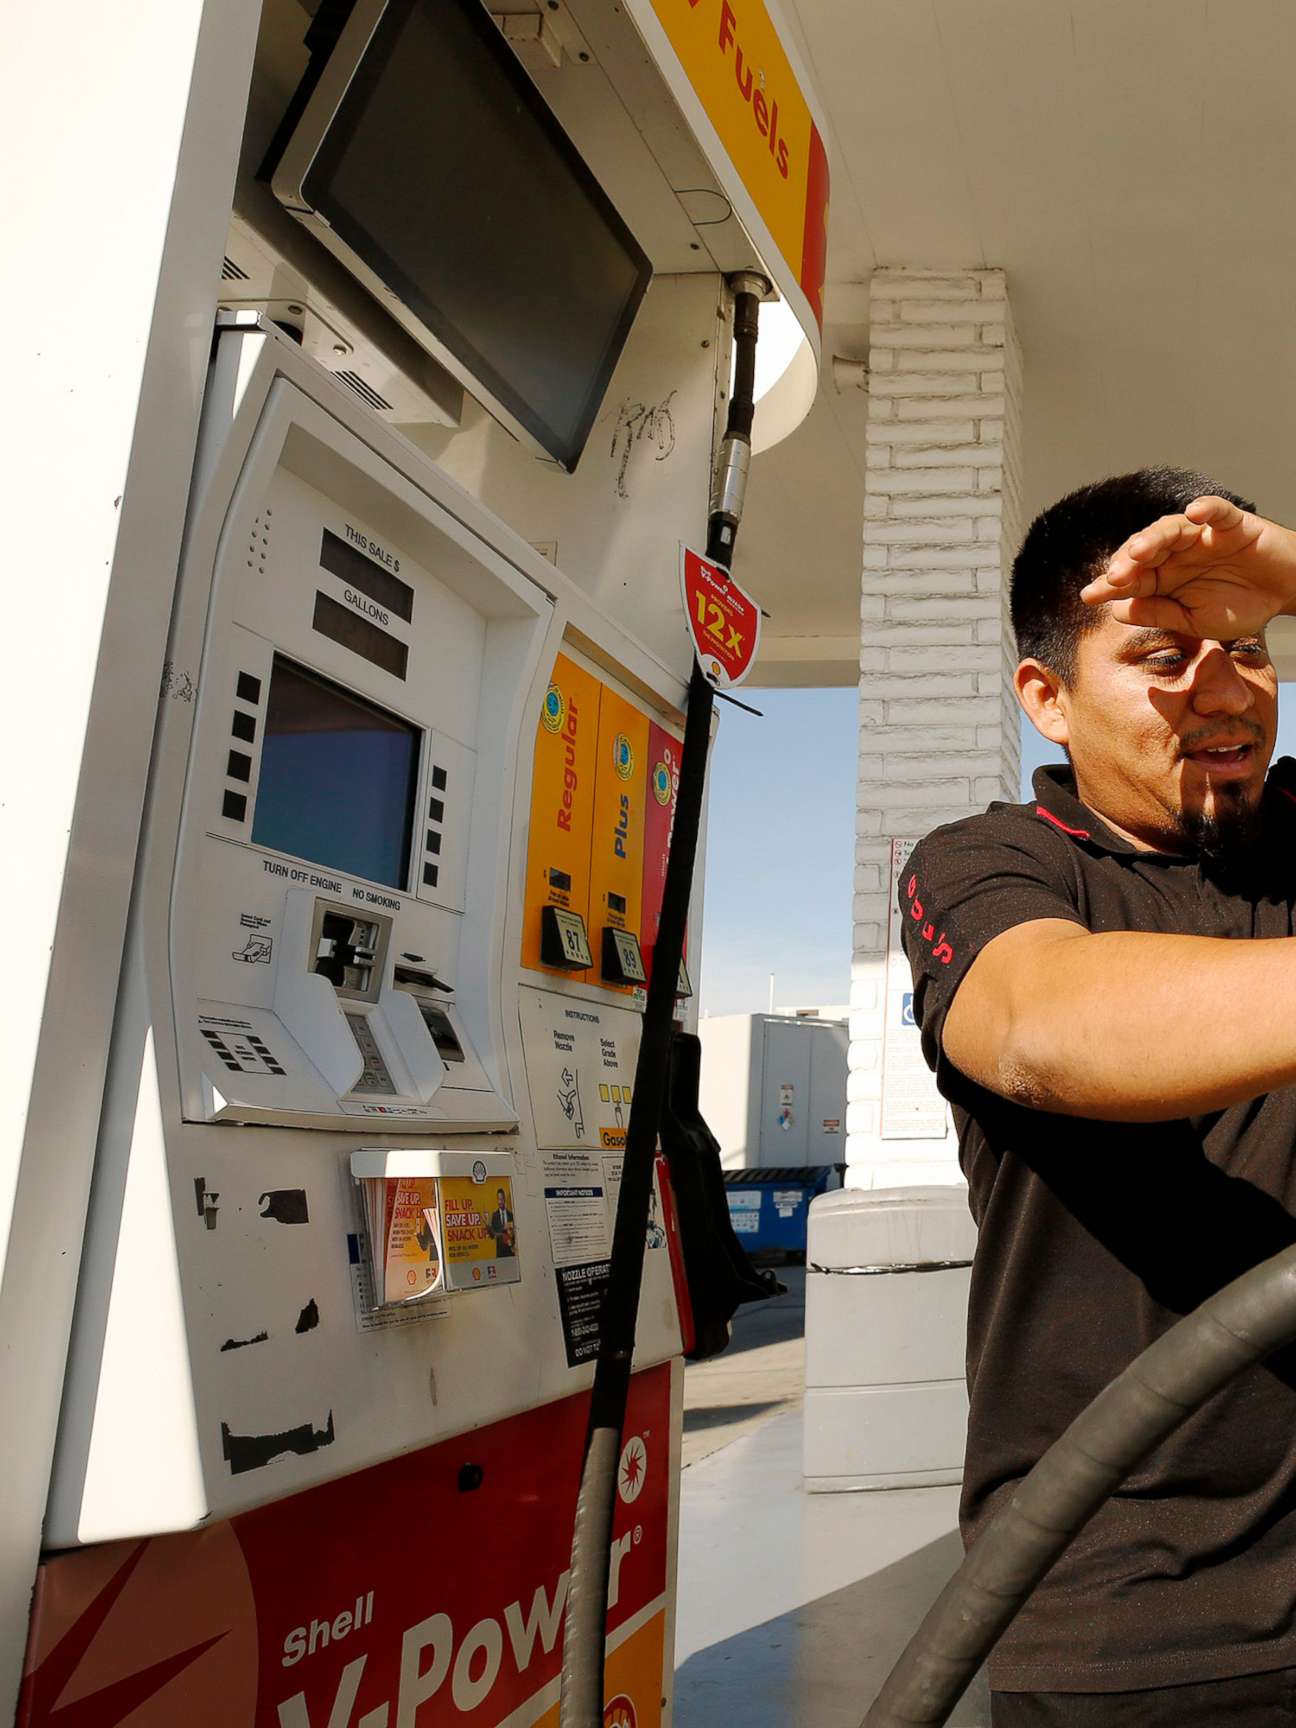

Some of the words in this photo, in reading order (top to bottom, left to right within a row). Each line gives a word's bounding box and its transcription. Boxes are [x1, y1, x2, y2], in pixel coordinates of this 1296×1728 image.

[719, 0, 788, 179] Fuels
[345, 524, 367, 548] THIS
[369, 542, 392, 567] SALE
[394, 560, 400, 572] $
[344, 589, 389, 625] GALLONS
[557, 697, 578, 832] Regular
[614, 793, 629, 860] Plus
[263, 861, 288, 877] TURN
[290, 869, 308, 882] OFF
[310, 875, 342, 893] ENGINE
[353, 888, 365, 900] NO
[366, 893, 400, 911] SMOKING
[566, 929, 581, 953] 87
[623, 948, 637, 969] 89
[564, 1009, 600, 1024] INSTRUCTIONS
[553, 1030, 575, 1042] Remove
[600, 1038, 615, 1048] Select
[555, 1041, 573, 1052] Nozzle
[601, 1048, 616, 1058] Grade
[603, 1058, 618, 1068] Above
[445, 1200, 460, 1211] FILL
[462, 1200, 474, 1211] UP.
[446, 1214, 466, 1226] SAVE
[468, 1213, 481, 1225] UP.
[447, 1229, 476, 1242] SNACK
[562, 1268, 587, 1281] NOZZLE
[282, 1591, 375, 1668] Shell
